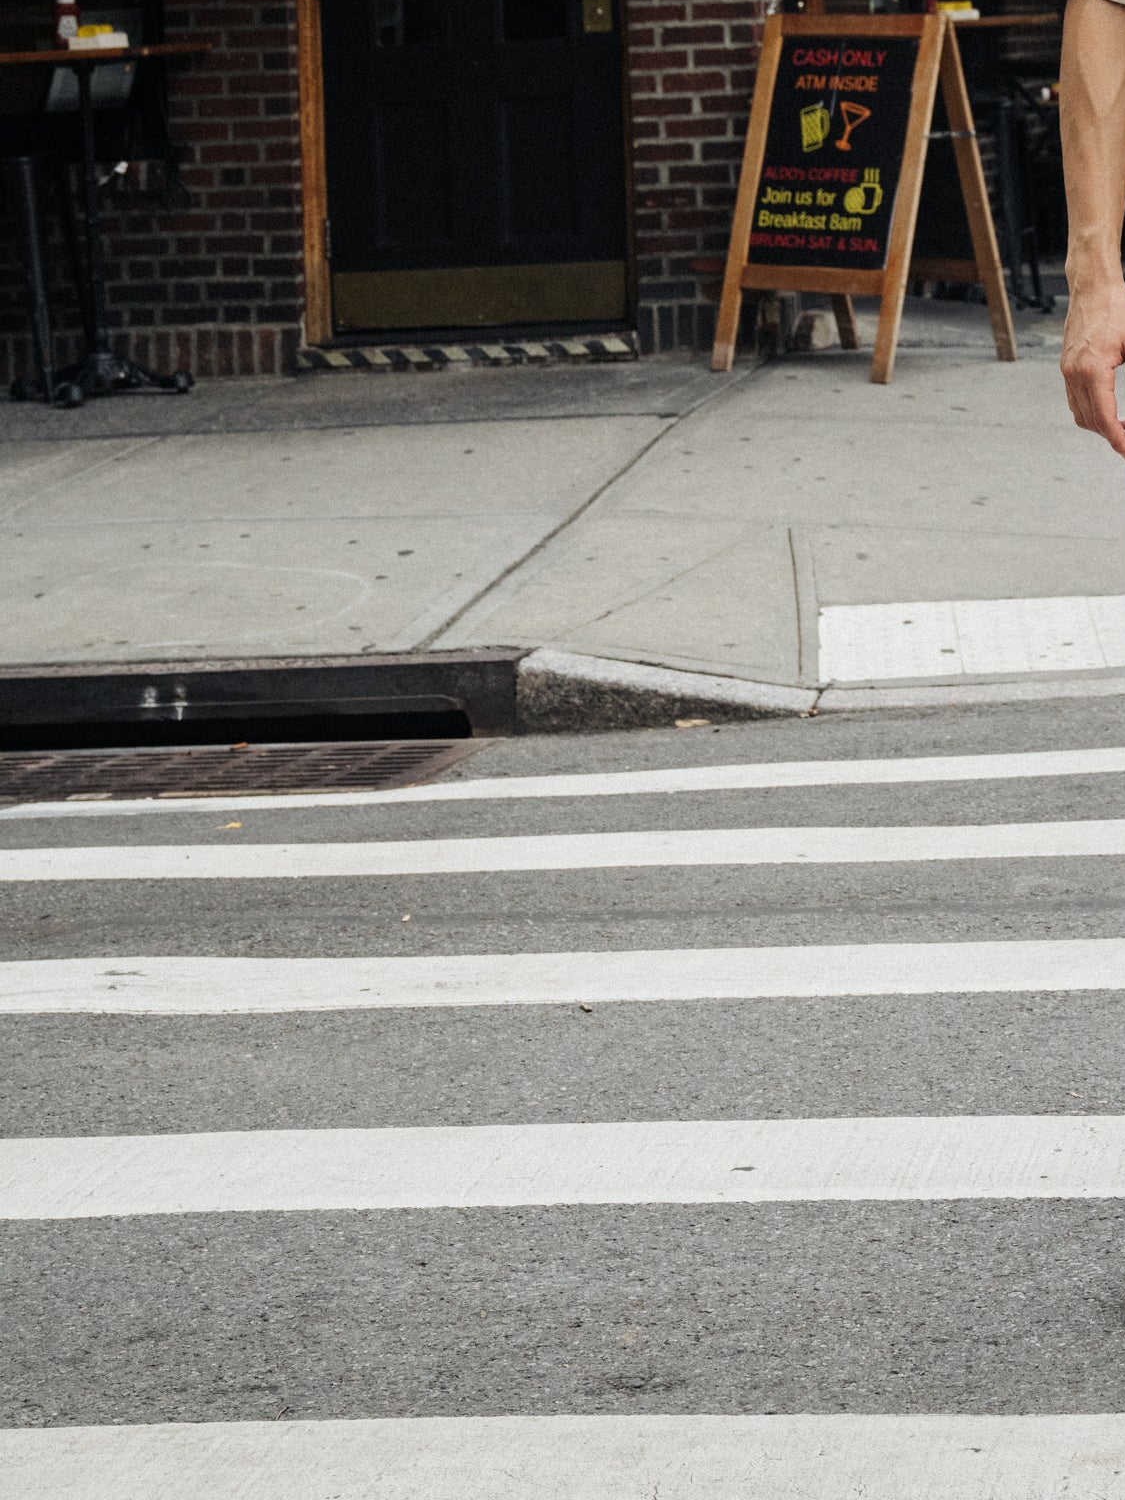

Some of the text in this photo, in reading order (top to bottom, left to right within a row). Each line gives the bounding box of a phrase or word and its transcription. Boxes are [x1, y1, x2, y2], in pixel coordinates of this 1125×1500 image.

[791, 48, 888, 68] CASH ONLY
[794, 74, 879, 92] ATM INSIDE
[808, 167, 858, 183] COFFEE
[761, 187, 837, 206] Join us for
[758, 209, 862, 231] Breakfast 8am
[808, 236, 833, 250] SAT
[849, 237, 879, 252] SUN
